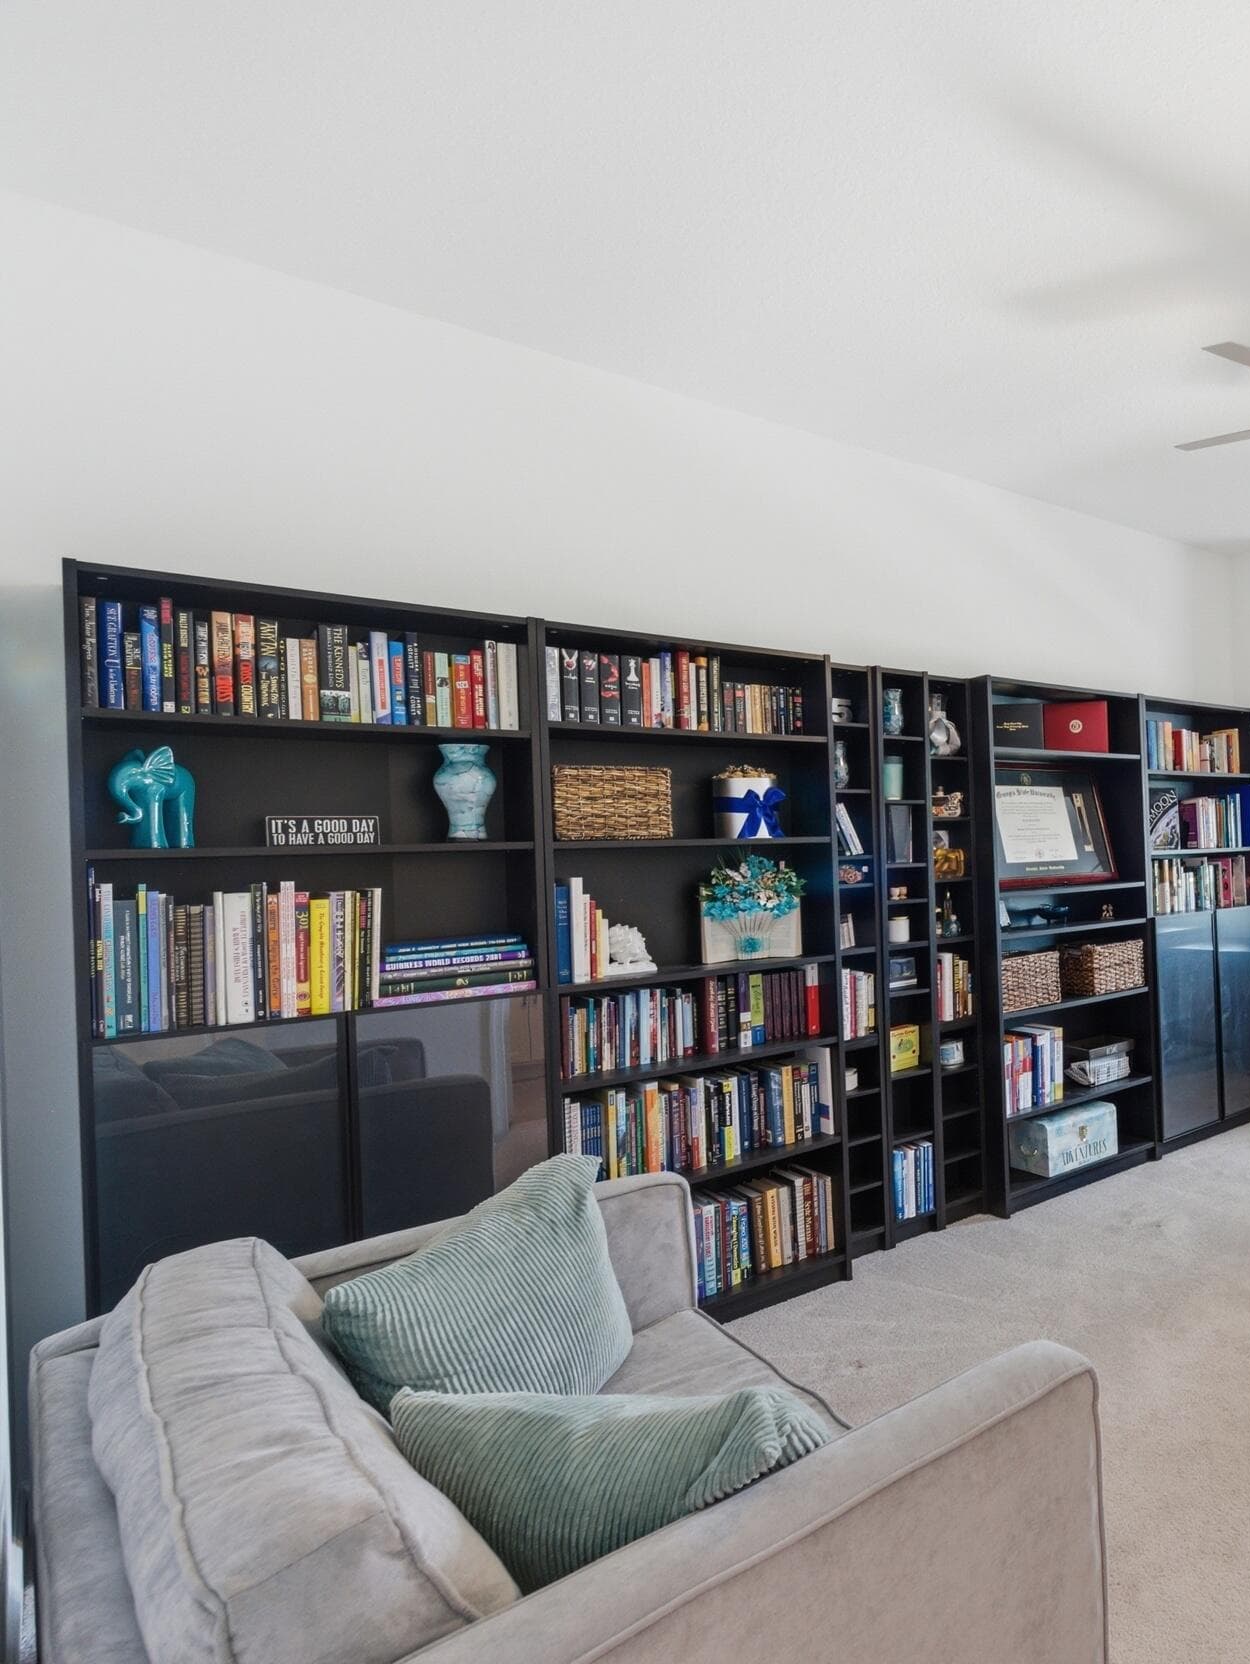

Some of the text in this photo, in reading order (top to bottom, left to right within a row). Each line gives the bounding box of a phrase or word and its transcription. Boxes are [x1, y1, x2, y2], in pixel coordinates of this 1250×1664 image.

[106, 608, 117, 657] SUE GRAFTON
[260, 621, 278, 657] AMY TAN
[105, 659, 120, 668] U
[333, 627, 345, 688] THE KENNEDYS
[407, 645, 415, 669] LOYALTY
[215, 675, 234, 703] CROSS
[239, 662, 254, 714] CROSS COUNTRY
[272, 819, 375, 833] IT'S A GOOD DAY
[272, 832, 375, 845] TO HAVE A GOOD DAY
[296, 911, 308, 929] 301
[384, 961, 424, 972] GUINNESS
[424, 958, 451, 968] WORLD
[451, 955, 484, 965] RECORDS
